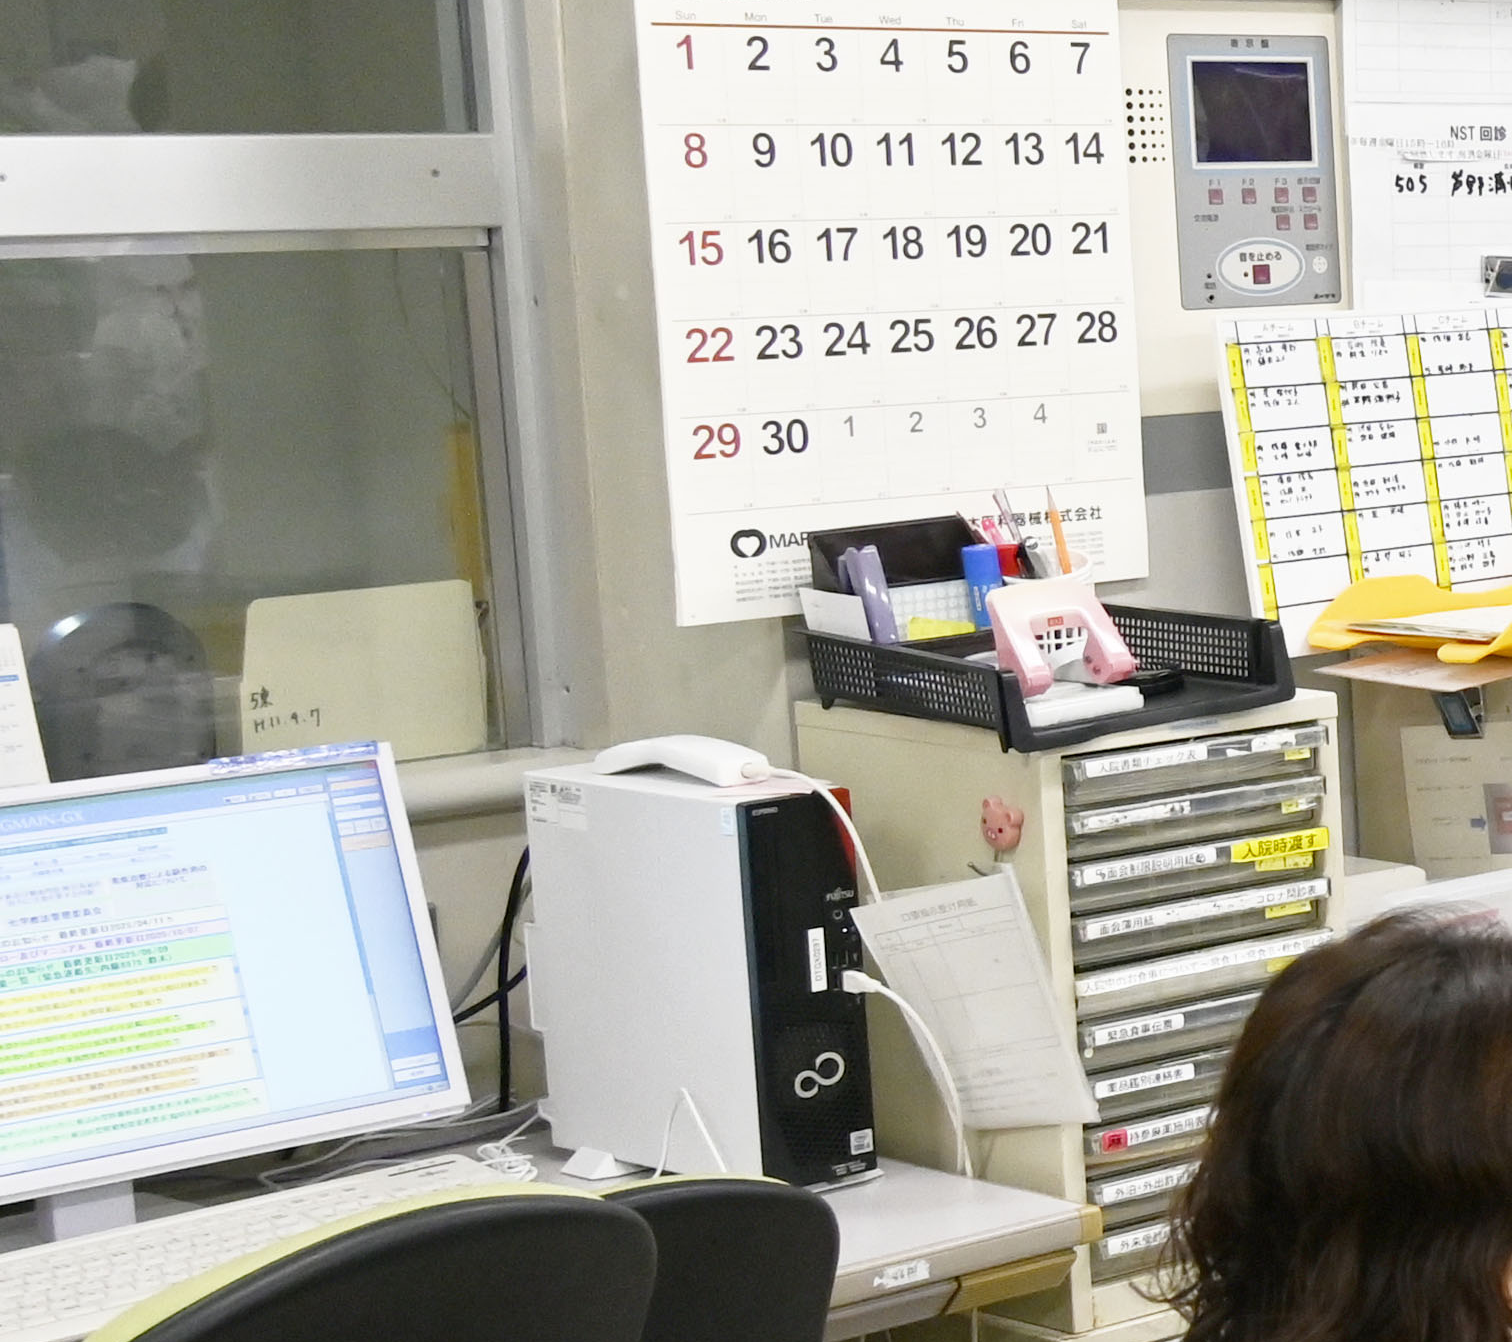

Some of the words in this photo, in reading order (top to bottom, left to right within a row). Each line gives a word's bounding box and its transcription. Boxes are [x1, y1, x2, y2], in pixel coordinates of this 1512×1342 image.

[675, 10, 696, 20] Sun
[745, 12, 767, 21] Mon
[814, 14, 833, 23] Tue
[879, 16, 901, 25] Wed
[946, 17, 964, 26] Thu
[1012, 19, 1024, 27] Fri
[677, 35, 693, 69] 1
[747, 36, 770, 70] 2
[816, 37, 837, 72] 3
[880, 39, 903, 72] 4
[948, 40, 968, 73] 5
[1010, 41, 1030, 74] 6
[1071, 42, 1090, 74] 7
[1450, 125, 1476, 140] NST
[1479, 125, 1507, 141] 回診
[684, 133, 707, 168] 8
[753, 133, 775, 167] 9
[811, 133, 852, 167] 10
[877, 133, 913, 166] 11
[942, 133, 982, 165] 12
[1005, 133, 1044, 165] 13
[1065, 132, 1104, 164] 14
[679, 231, 723, 265] 15
[748, 229, 791, 263] 16
[817, 228, 857, 261] 17
[883, 226, 923, 259] 18
[947, 225, 986, 257] 19
[1010, 223, 1051, 256] 20
[1072, 222, 1107, 254] 21
[1240, 251, 1283, 262] 音を止める
[686, 327, 734, 363] 22
[756, 324, 802, 360] 23
[824, 321, 870, 356] 24
[890, 319, 934, 353] 25
[955, 316, 997, 350] 26
[1016, 313, 1056, 346] 27
[1077, 311, 1117, 343] 28
[693, 423, 740, 459] 29
[762, 419, 808, 455] 30
[844, 416, 853, 437] 1
[910, 411, 923, 432] 2
[974, 407, 986, 428] 3
[1034, 403, 1047, 423] 4
[250, 686, 274, 709] 5東
[1244, 833, 1318, 860] 入院時渡す
[826, 886, 855, 902] FUJITSU
[1107, 1018, 1173, 1040] 緊急食事伝票
